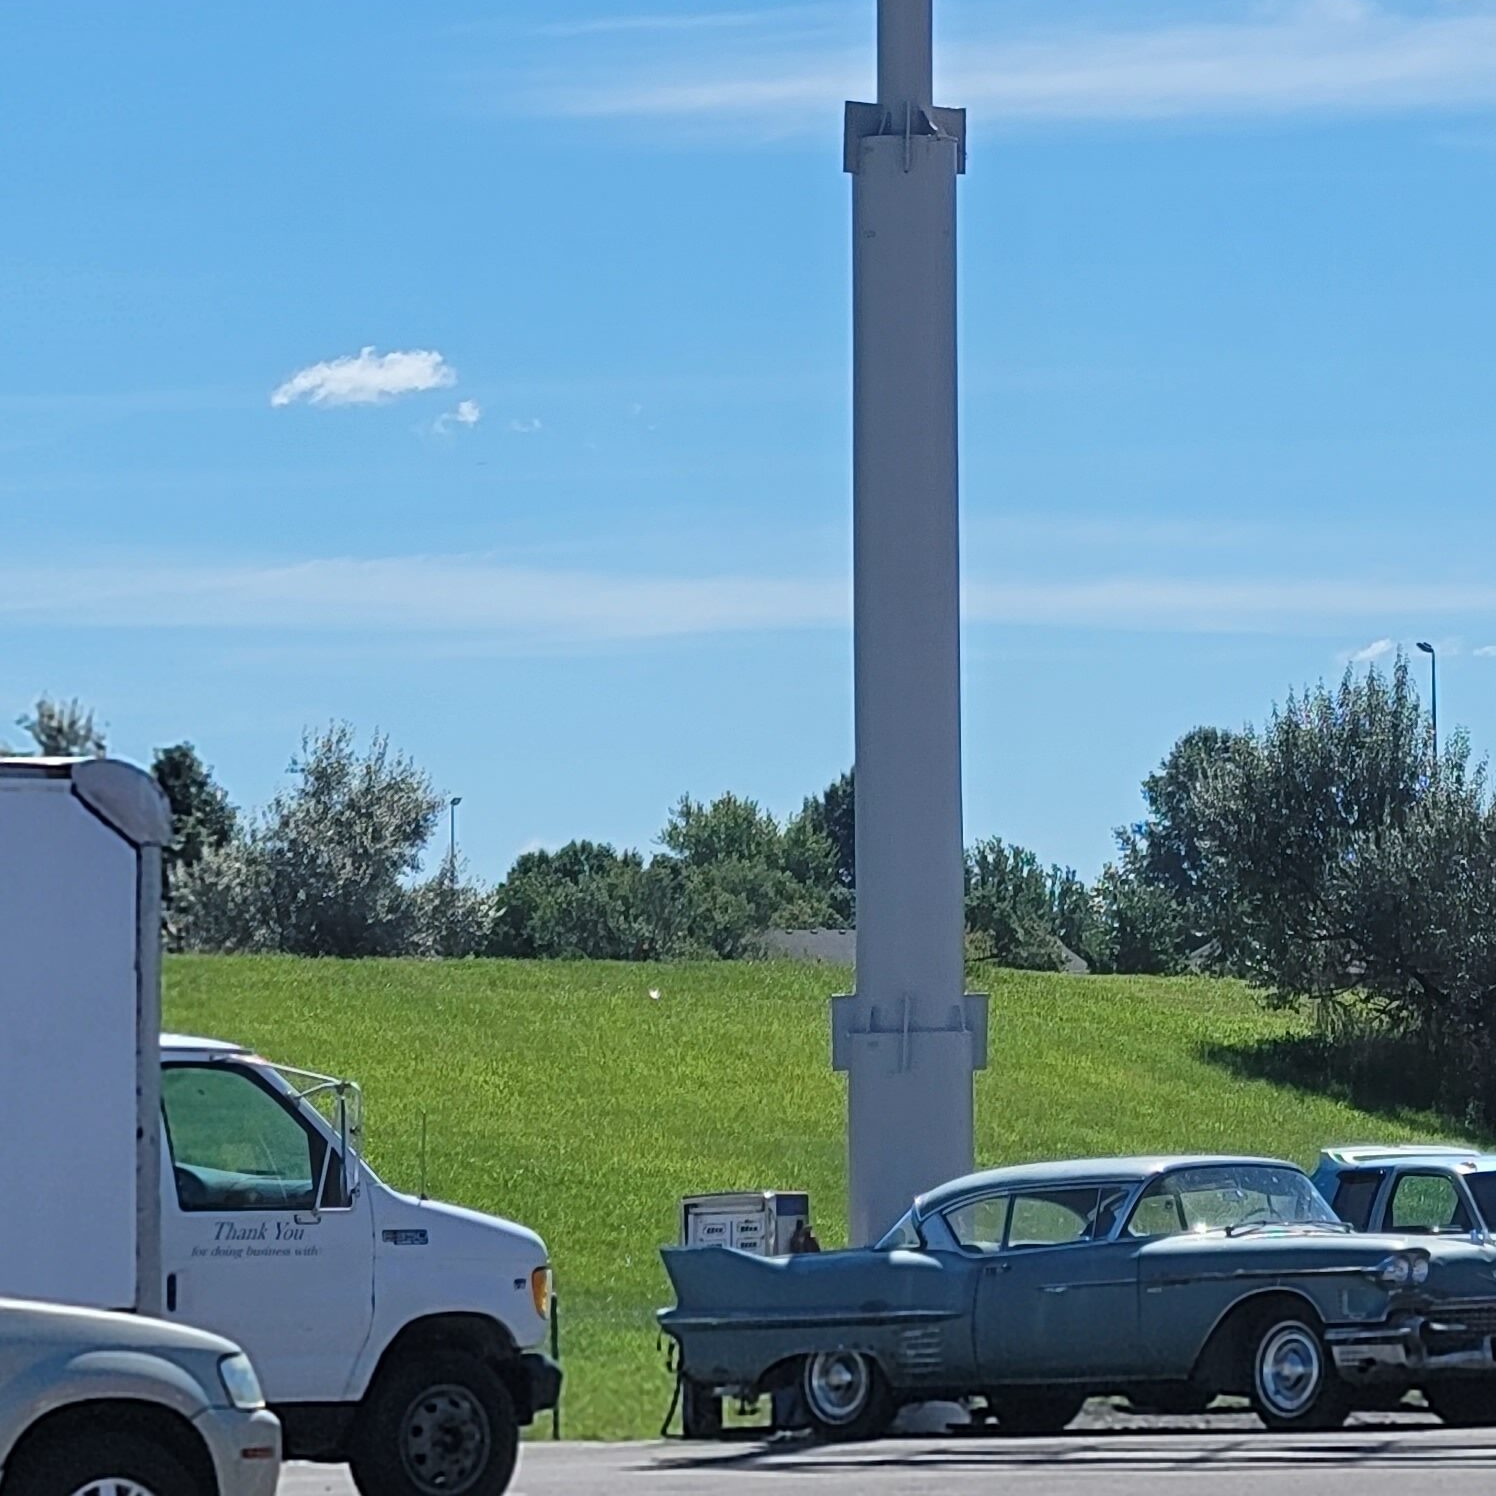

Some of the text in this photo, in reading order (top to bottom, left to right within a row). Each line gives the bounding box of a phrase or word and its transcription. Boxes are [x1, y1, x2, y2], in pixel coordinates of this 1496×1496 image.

[214, 1221, 304, 1241] Thank You
[191, 1245, 318, 1259] for doing business with
